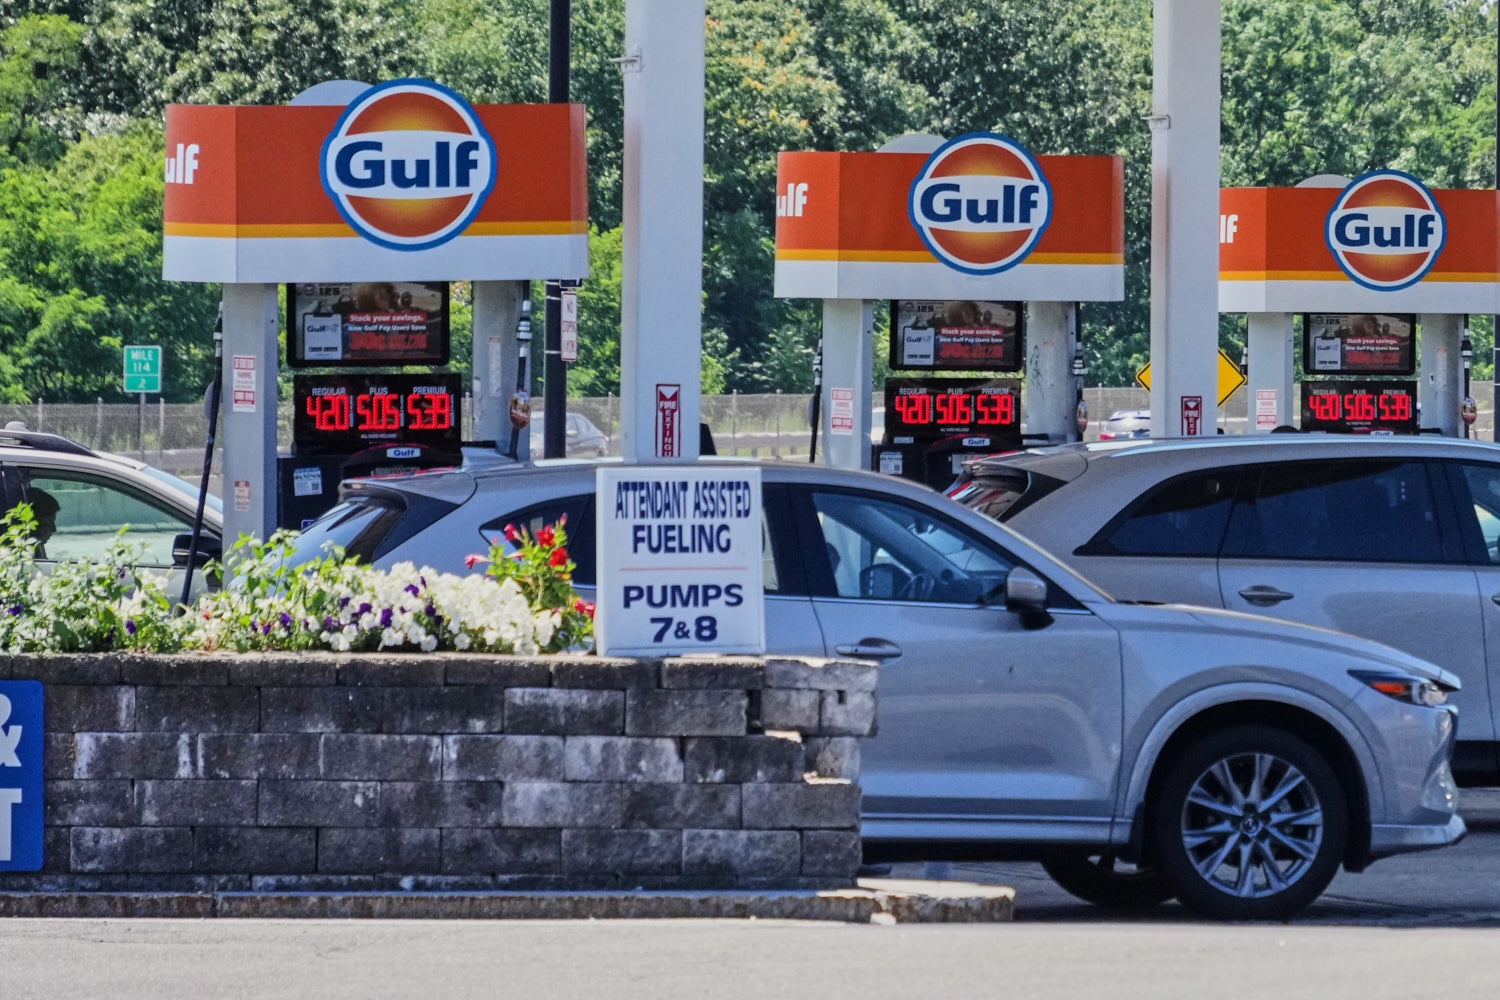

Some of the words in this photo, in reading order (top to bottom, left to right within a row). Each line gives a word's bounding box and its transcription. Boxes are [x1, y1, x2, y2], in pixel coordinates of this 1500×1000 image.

[335, 140, 479, 189] Gulf
[920, 182, 1039, 224] Gulf
[1335, 213, 1435, 248] Gulf
[131, 350, 154, 361] MILE
[133, 362, 151, 373] 114
[139, 378, 146, 389] 2
[312, 387, 346, 396] REGULAR
[369, 386, 388, 395] PLUS
[412, 386, 446, 395] PREMIUM
[899, 387, 927, 395] REGULAR
[947, 387, 963, 395] PLUS
[981, 387, 1009, 395] PREMIUM
[660, 401, 677, 409] FIRE
[393, 448, 415, 457] Gulf
[615, 481, 689, 519] ATTENDANT
[693, 481, 751, 519] ASSISTED
[632, 524, 731, 554] FUELING
[623, 583, 744, 609] PUMPS
